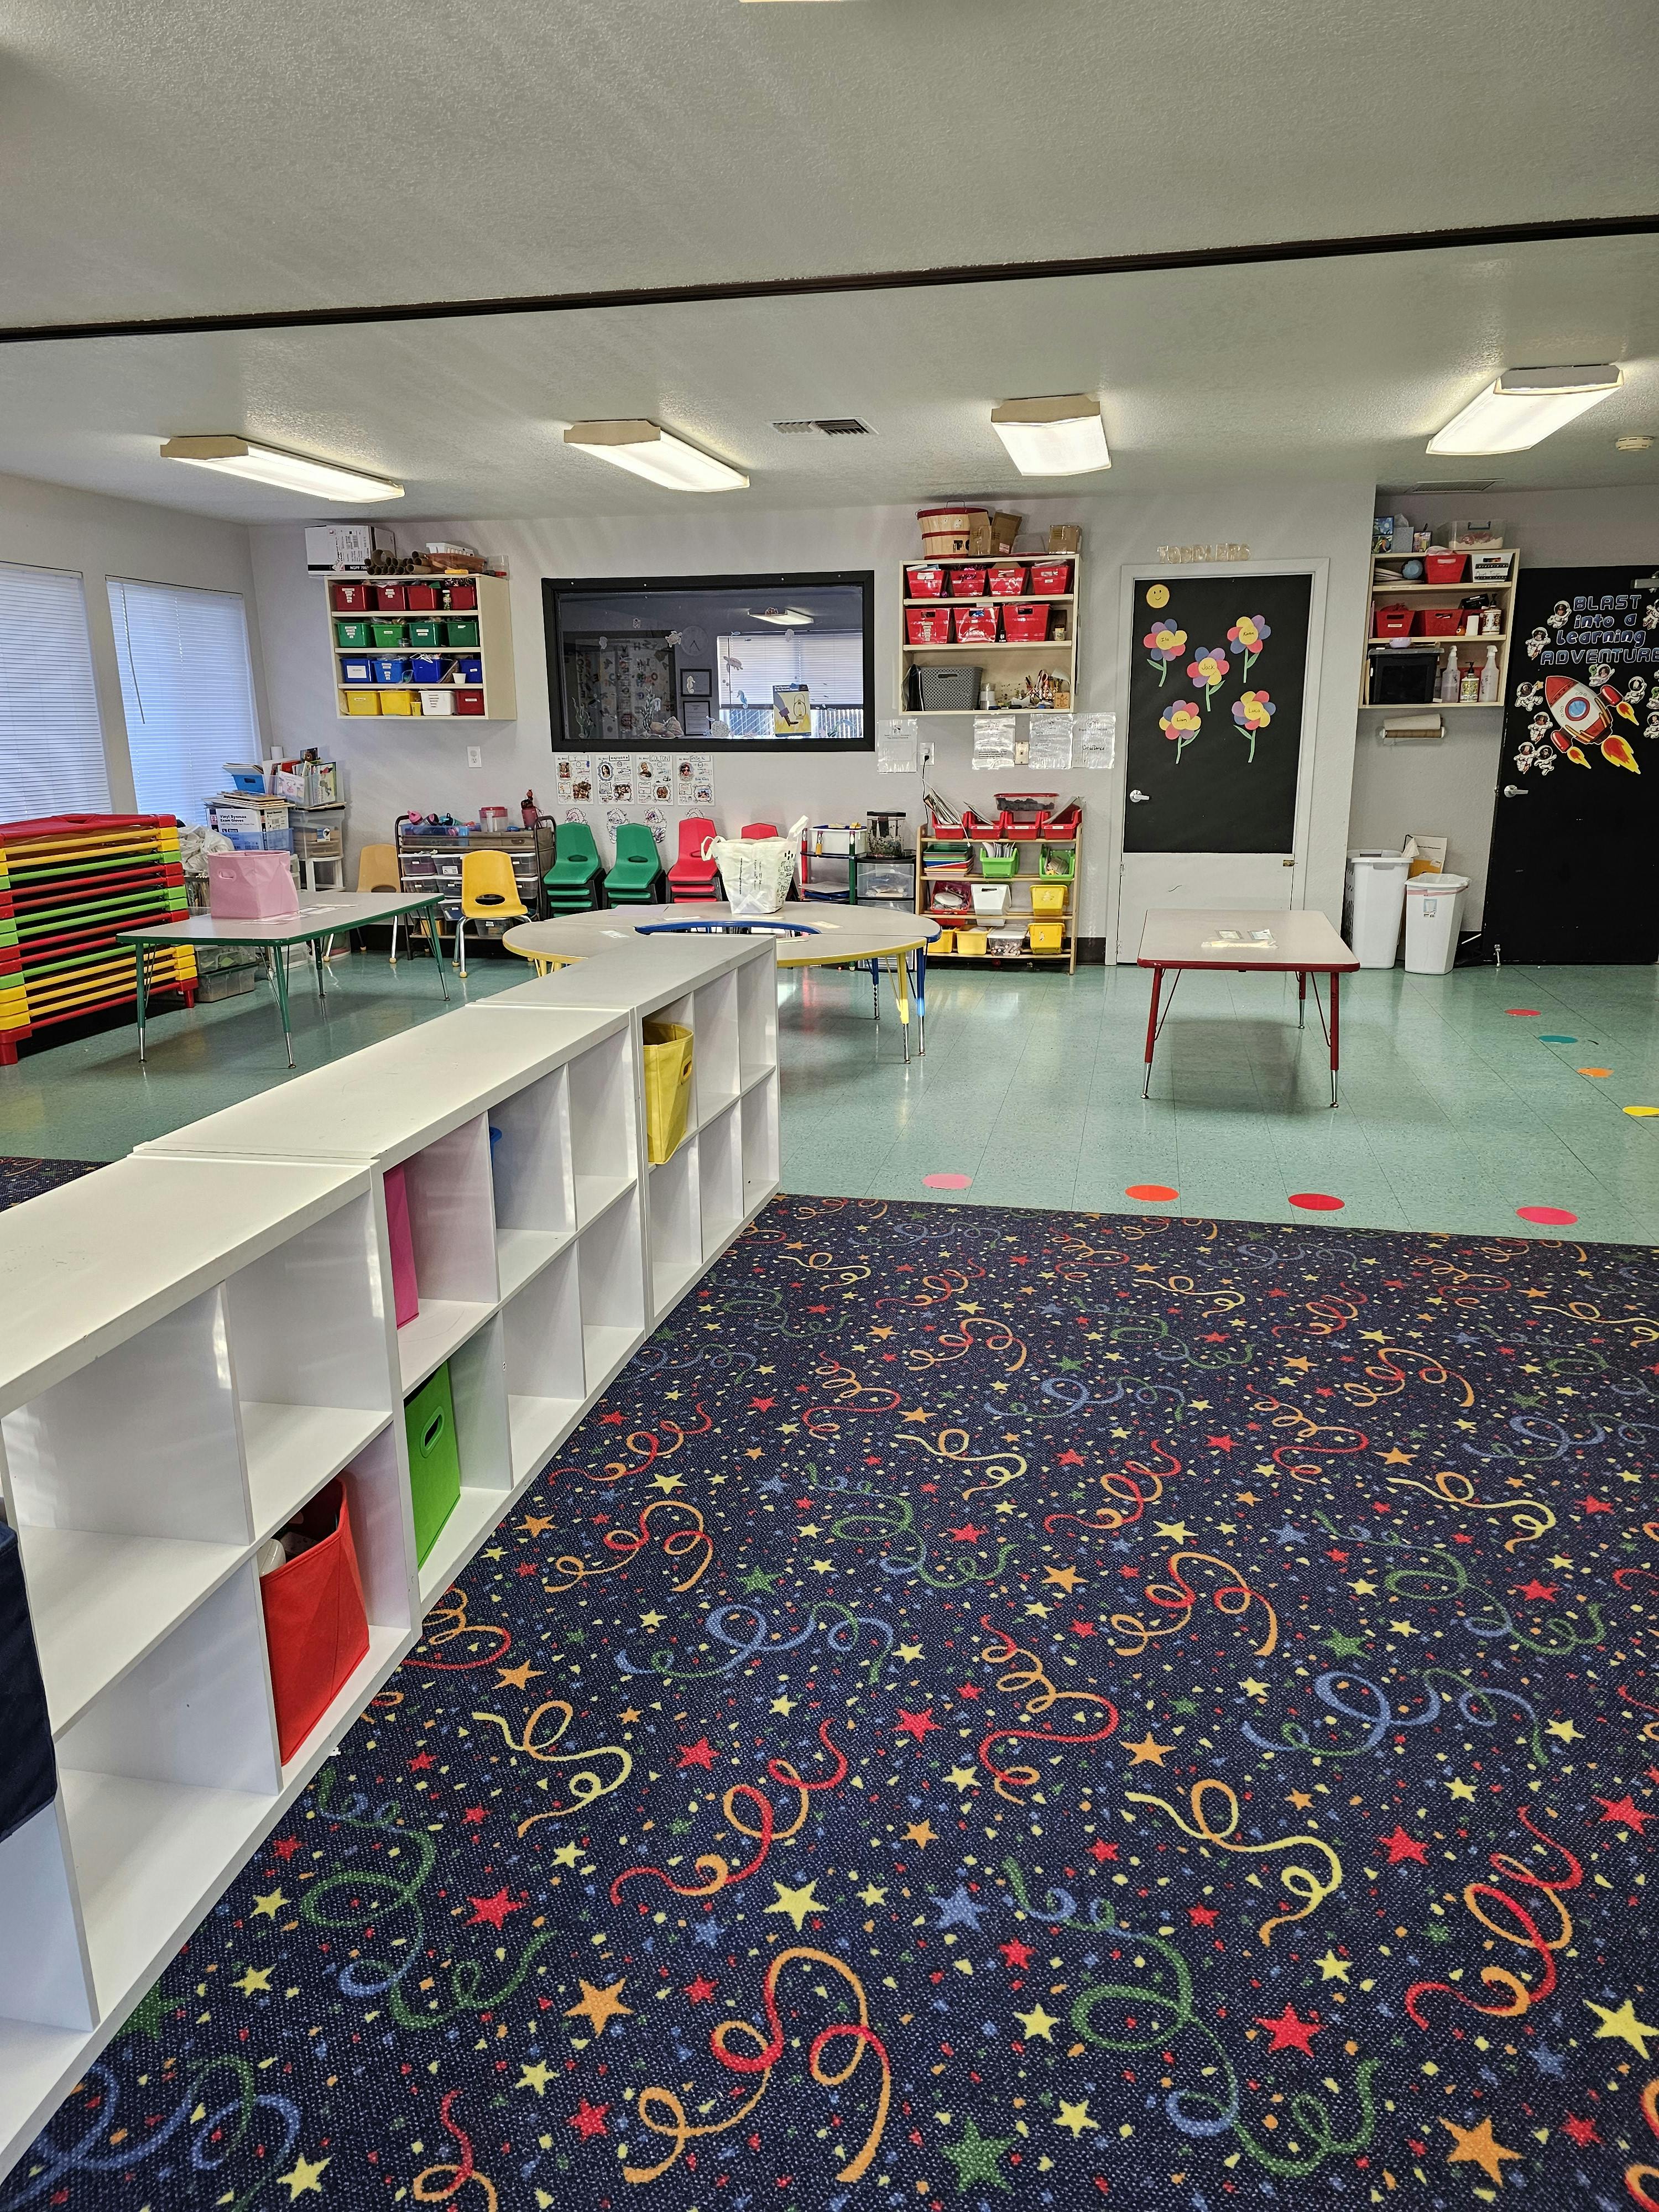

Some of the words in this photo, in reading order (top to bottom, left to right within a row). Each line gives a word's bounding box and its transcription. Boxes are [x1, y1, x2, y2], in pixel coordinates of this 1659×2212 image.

[1157, 544, 1251, 564] TODDLERS
[1573, 595, 1642, 611] BLAST
[1574, 614, 1614, 629] into
[1624, 613, 1637, 626] a
[1540, 648, 1659, 665] ADVENTURE
